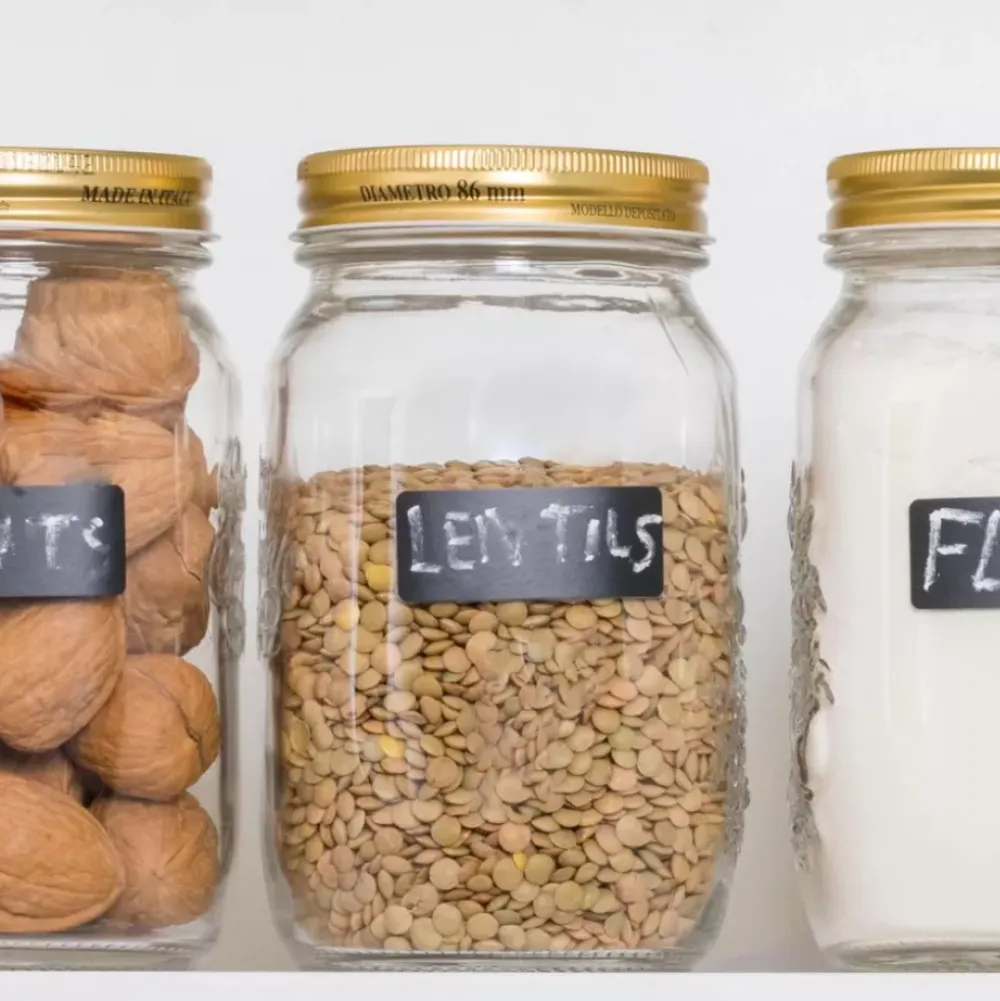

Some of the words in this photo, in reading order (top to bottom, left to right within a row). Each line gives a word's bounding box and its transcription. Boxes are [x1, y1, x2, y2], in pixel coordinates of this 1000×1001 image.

[81, 185, 136, 203] MADE
[139, 188, 158, 205] IN
[360, 183, 450, 202] DIAMETRO
[456, 179, 481, 201] 86
[487, 185, 525, 202] mm
[570, 203, 622, 219] MODELLO
[407, 503, 663, 573] LENTILS
